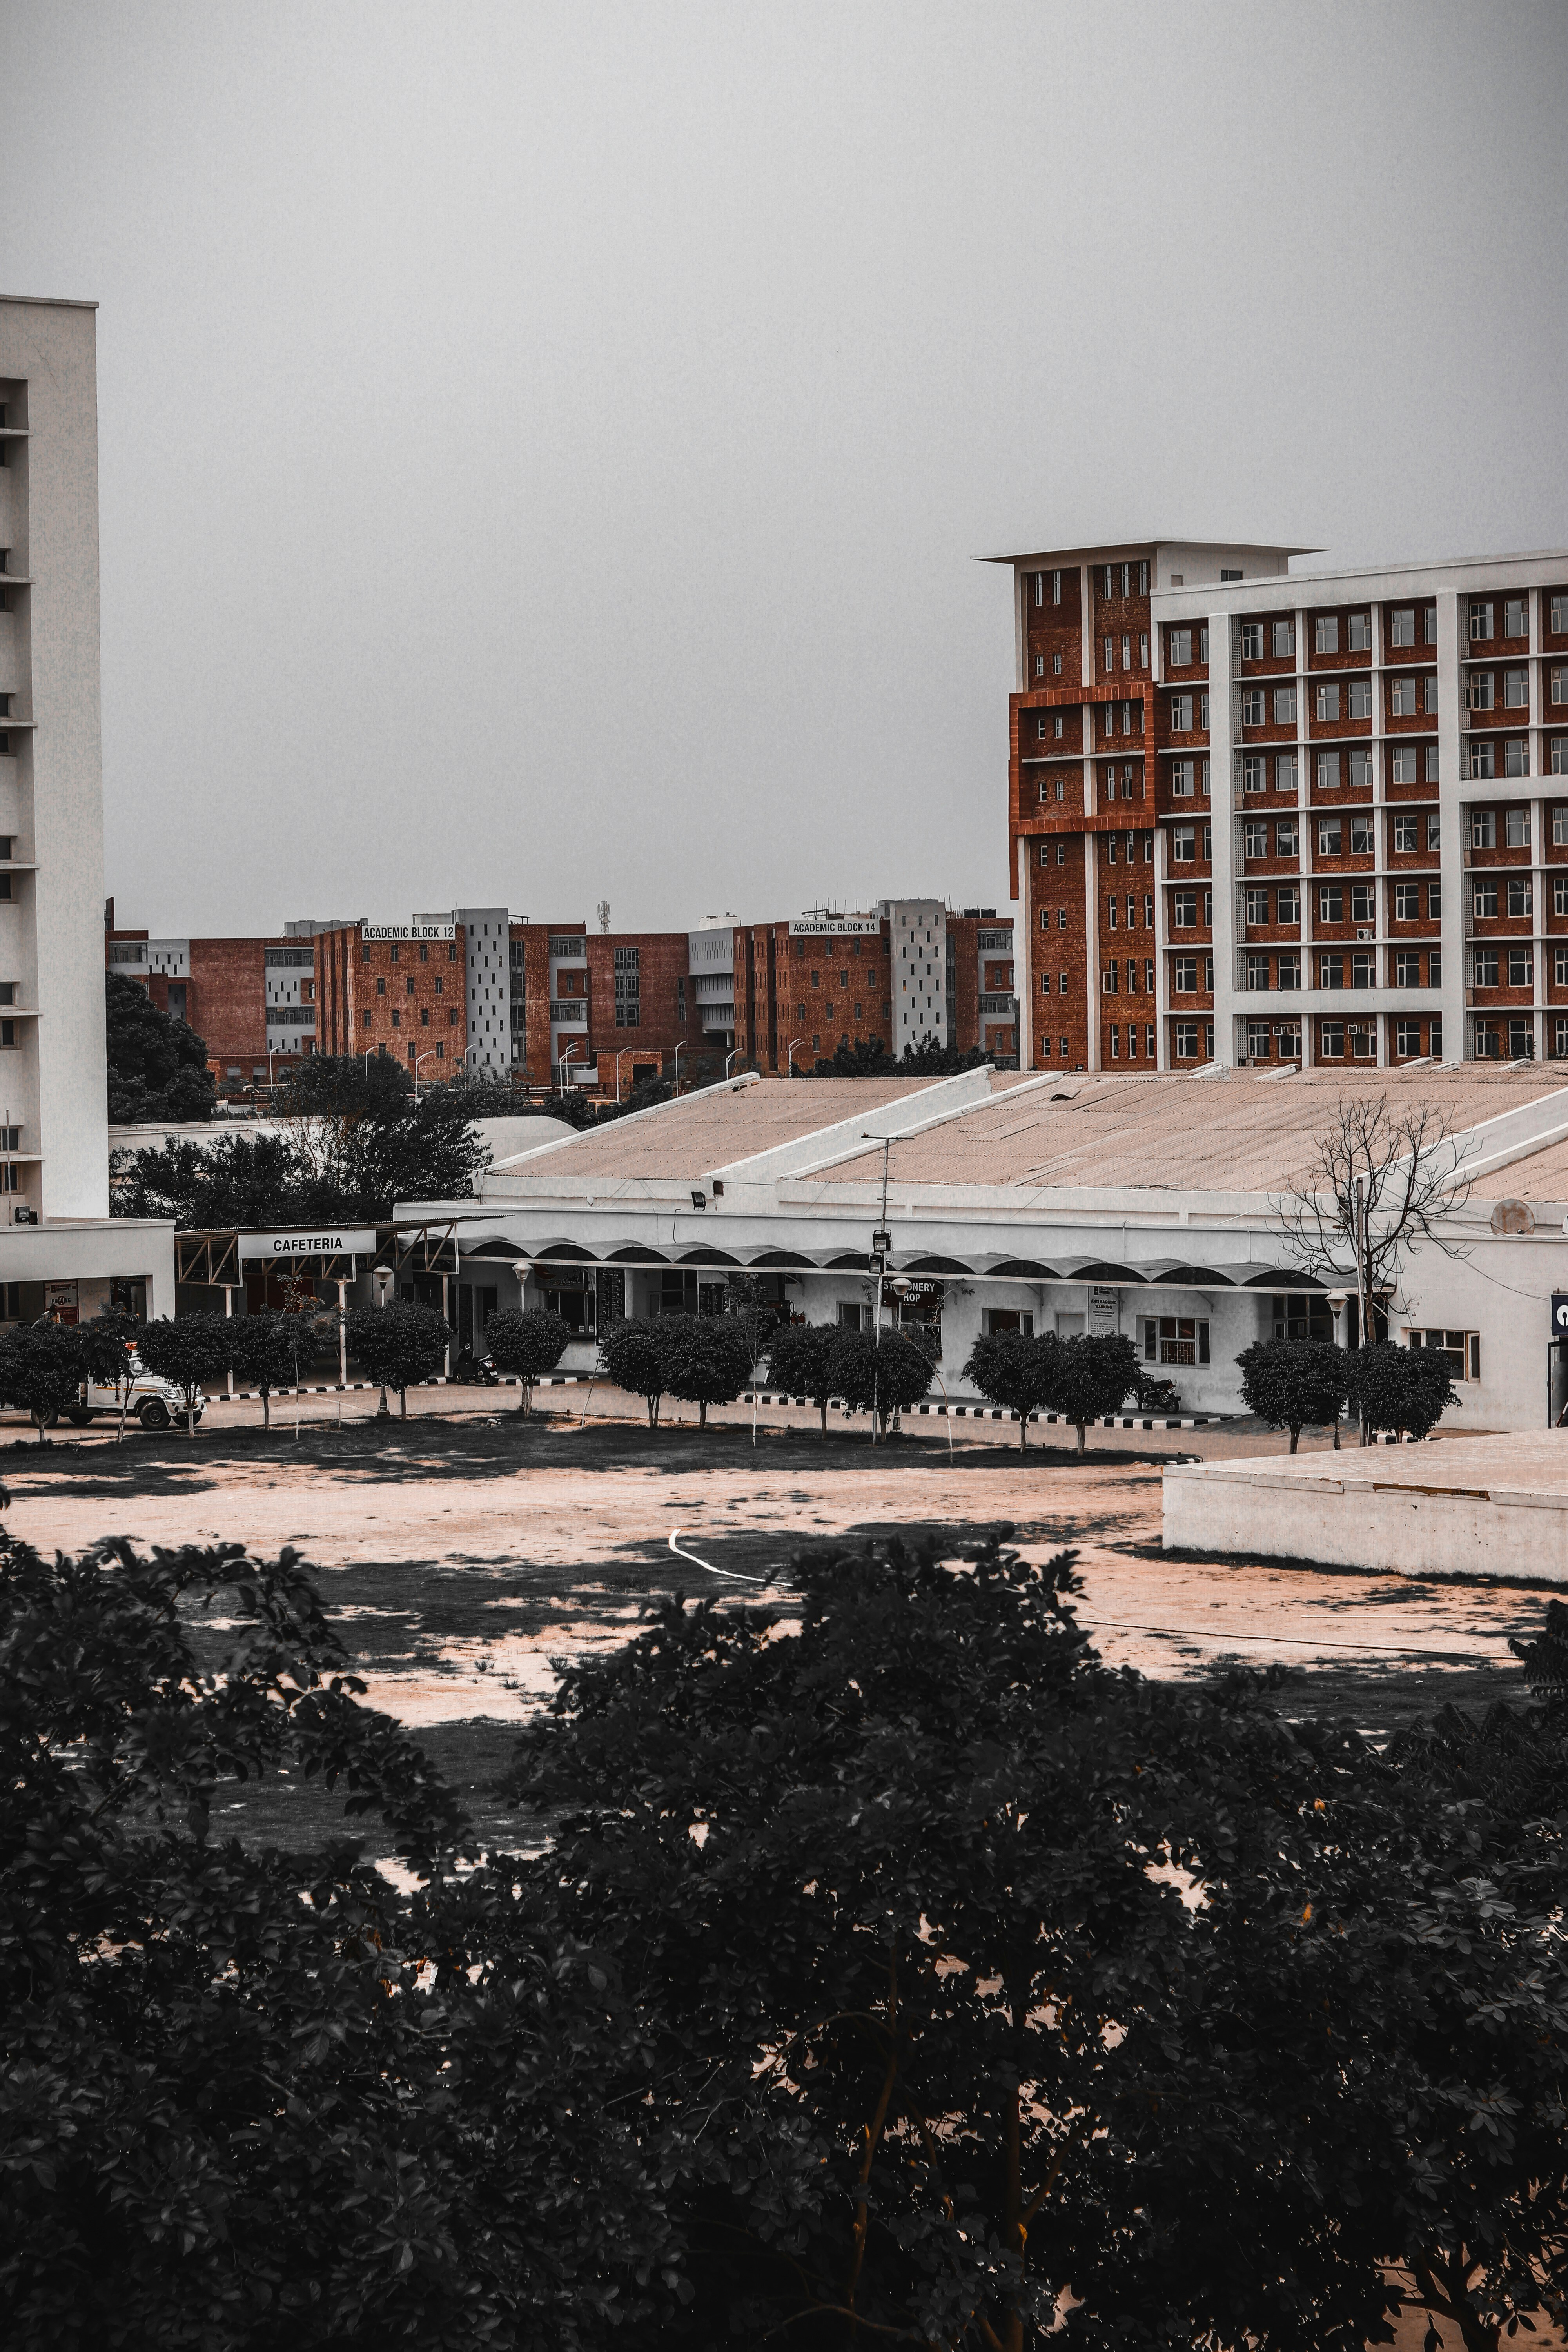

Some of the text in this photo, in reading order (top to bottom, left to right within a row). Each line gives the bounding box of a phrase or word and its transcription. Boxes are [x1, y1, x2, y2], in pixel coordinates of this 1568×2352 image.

[364, 927, 454, 938] ACADEMIC BLOCK 12
[793, 923, 875, 932] ACADEMIC BLOCK 14
[273, 1237, 343, 1252] CAFETERIA
[883, 1281, 935, 1292] STONERY
[904, 1293, 920, 1302] HOP
